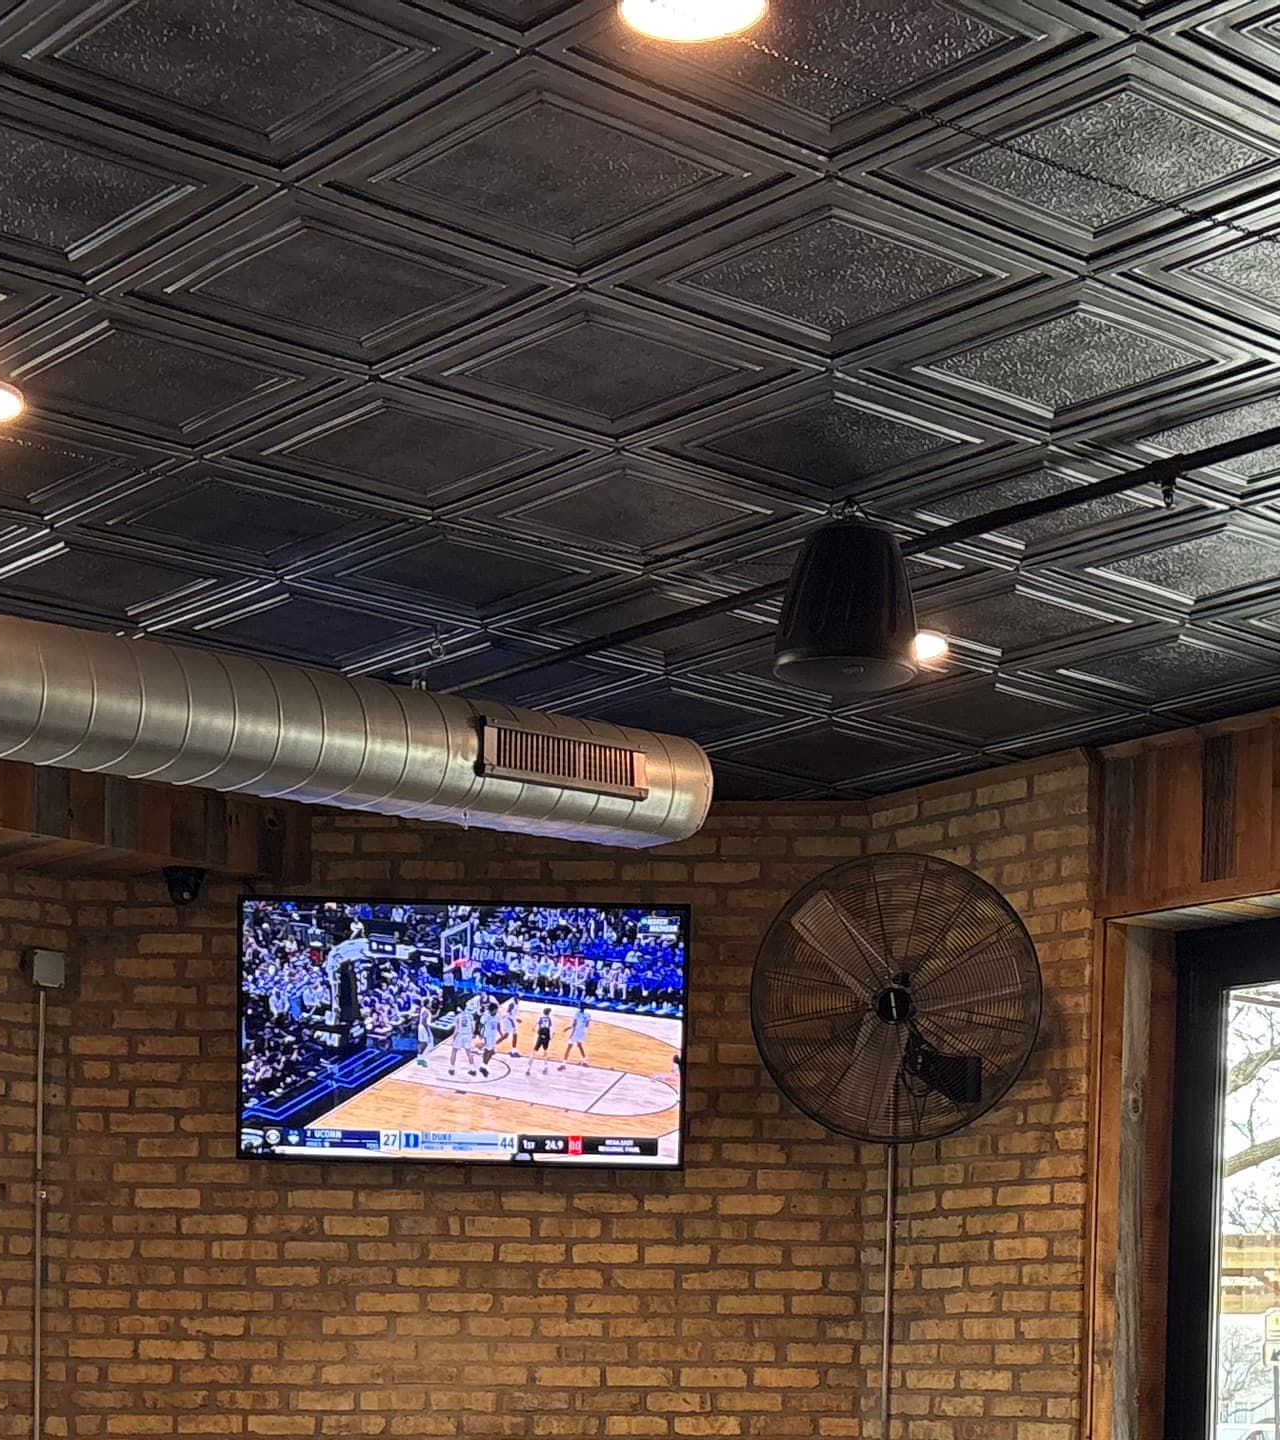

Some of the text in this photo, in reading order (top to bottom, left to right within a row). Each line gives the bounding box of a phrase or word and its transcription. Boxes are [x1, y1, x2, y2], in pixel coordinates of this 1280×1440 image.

[382, 1134, 398, 1147] 27
[500, 1136, 515, 1149] 44
[544, 1140, 564, 1151] 24.9
